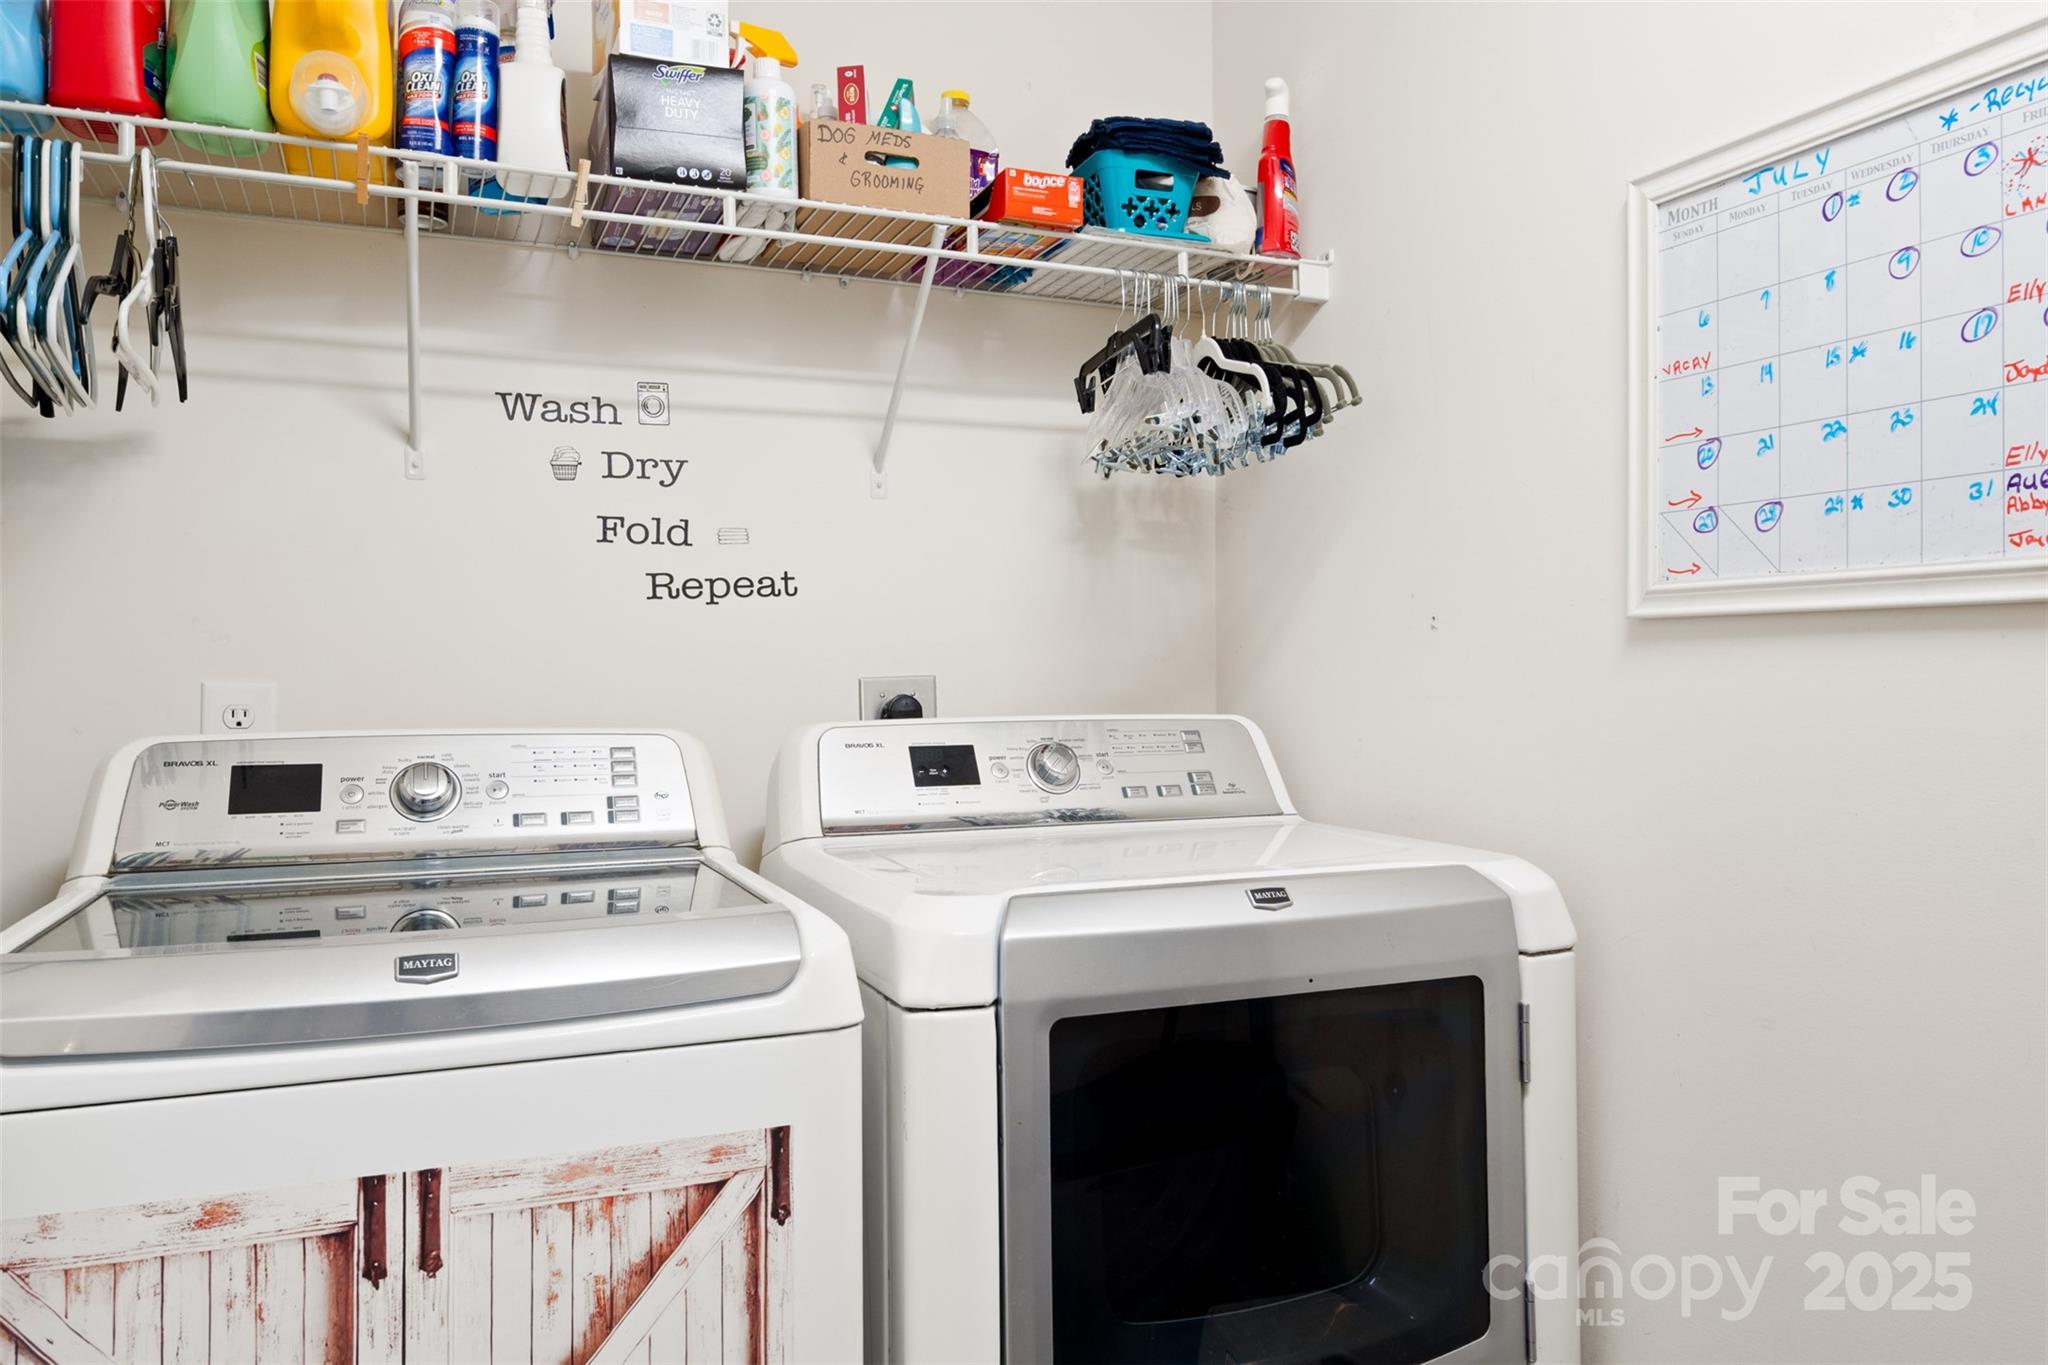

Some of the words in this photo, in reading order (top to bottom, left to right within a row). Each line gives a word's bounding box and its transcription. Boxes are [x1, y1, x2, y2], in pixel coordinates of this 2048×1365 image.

[411, 71, 434, 82] OXI
[652, 64, 704, 84] Swiffer
[406, 81, 442, 93] CLEAN
[661, 95, 701, 109] HEAVY
[665, 106, 699, 120] DUTY
[817, 124, 856, 144] DOG
[865, 131, 912, 149] MEDS
[1930, 127, 1990, 154] THURSDAY
[719, 167, 732, 177] 20
[1743, 147, 1830, 195] JULY
[1850, 152, 1914, 181] WEDNESDAY
[850, 170, 924, 195] GROOMING
[1023, 173, 1065, 188] bounce
[1791, 180, 1834, 202] TUESDAY
[1667, 196, 1719, 226] MONTH
[1728, 203, 1767, 222] MONDAY
[1672, 224, 1705, 242] SUNDAY
[1760, 361, 1774, 384] 14
[494, 391, 622, 426] Wash
[600, 451, 689, 488] Dry
[1888, 487, 1913, 508] 30
[595, 515, 694, 548] Fold
[645, 570, 799, 606] Repeat
[163, 760, 204, 768] BRAVOS
[340, 775, 365, 784] power
[1253, 890, 1287, 899] MAYTAG
[402, 957, 453, 970] MAYTAG
